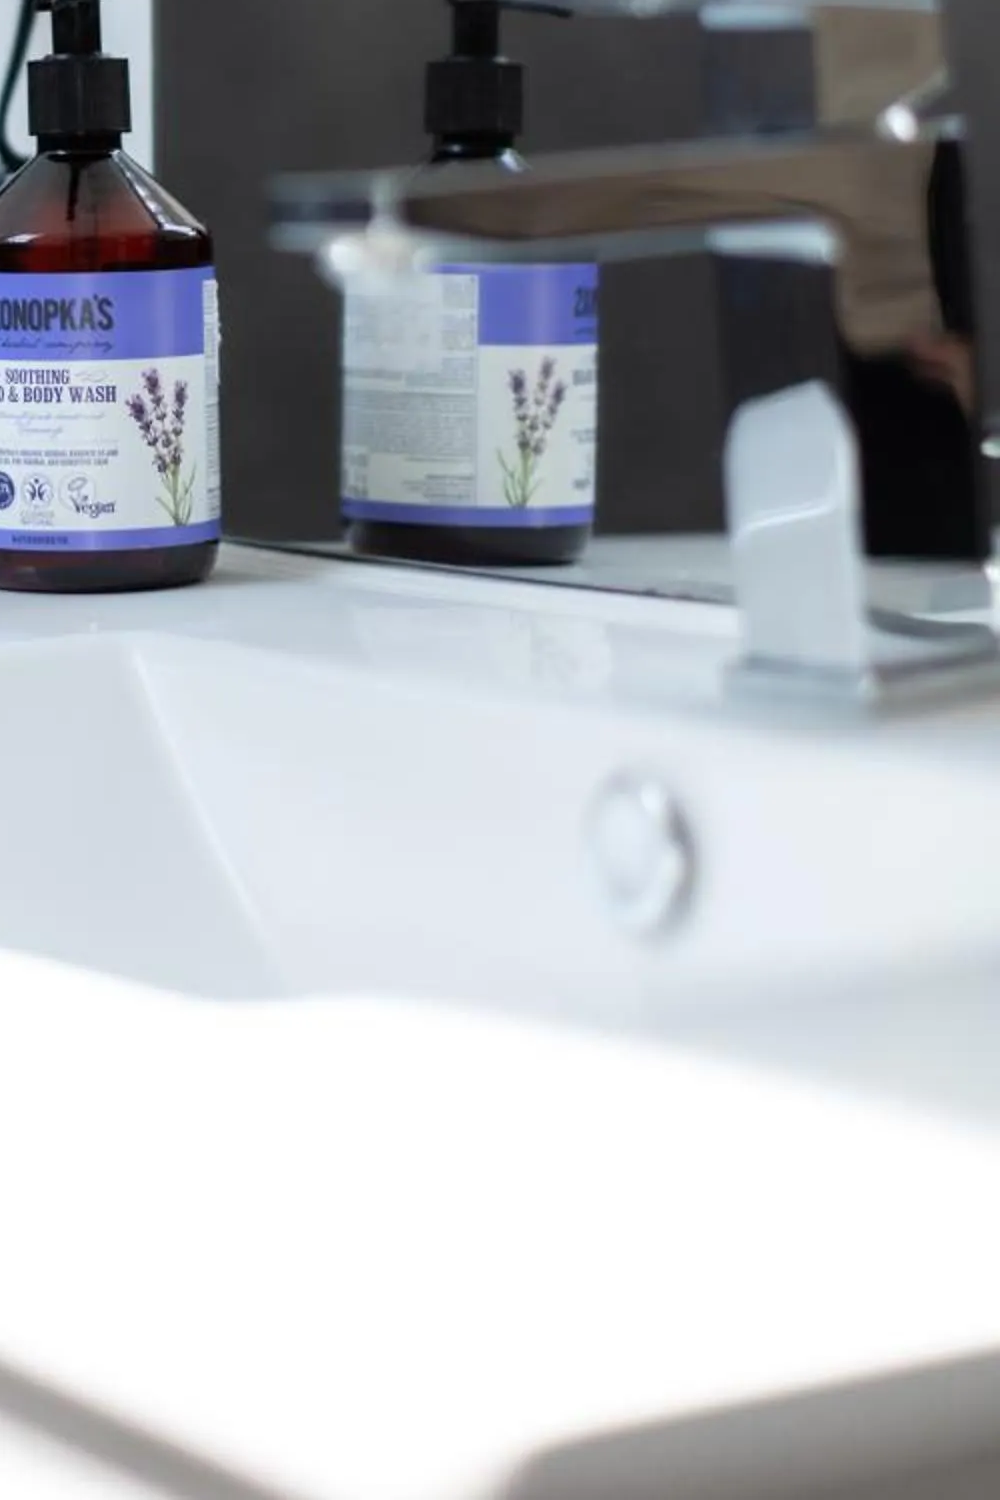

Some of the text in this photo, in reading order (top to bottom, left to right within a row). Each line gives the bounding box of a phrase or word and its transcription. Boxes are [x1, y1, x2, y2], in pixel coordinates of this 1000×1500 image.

[5, 369, 71, 385] SOOTHING
[8, 386, 19, 403] &
[23, 386, 64, 403] BODY
[69, 385, 117, 404] WASH
[69, 495, 116, 518] Vegan
